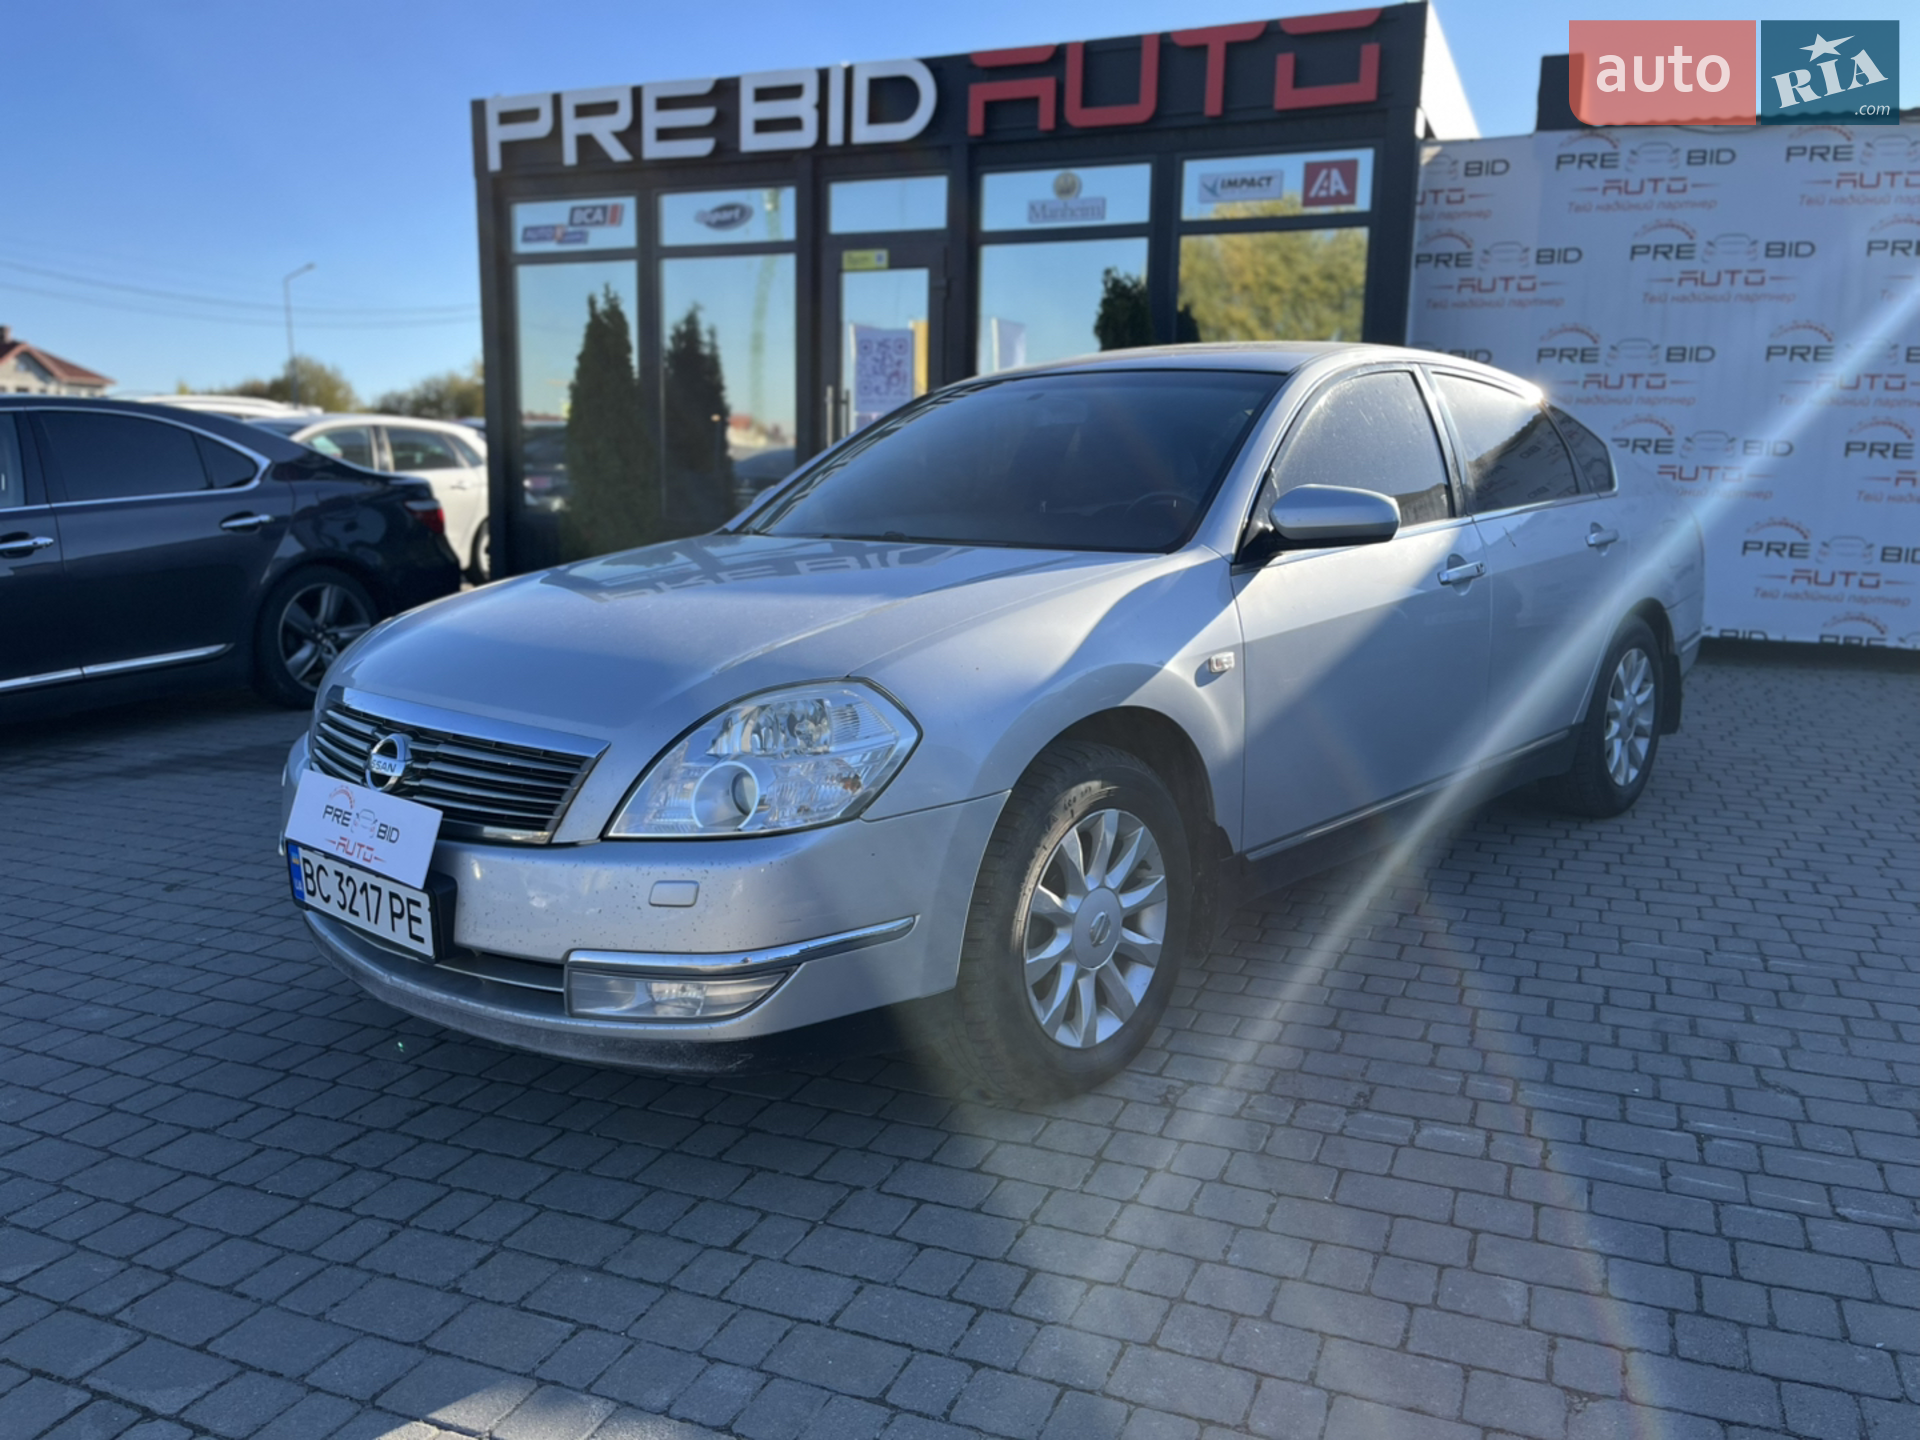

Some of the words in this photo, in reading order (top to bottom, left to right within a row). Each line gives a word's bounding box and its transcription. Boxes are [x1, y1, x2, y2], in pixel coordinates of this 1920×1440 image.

[486, 77, 717, 171] PRE
[740, 59, 937, 152] BID
[967, 7, 1383, 136] AUTO
[1556, 152, 1620, 171] PRE
[1686, 148, 1737, 166] BID
[1785, 145, 1854, 163] PRE
[1464, 159, 1510, 177] BID
[1220, 175, 1273, 190] IMPACT
[1602, 177, 1688, 196] AUTO
[1416, 188, 1465, 206] UTO
[1630, 243, 1696, 261] PRE
[1765, 241, 1816, 258] BID
[1867, 240, 1920, 257] PR
[1414, 252, 1474, 269] PRE
[1535, 247, 1583, 265] BID
[1457, 275, 1537, 293] AUTO
[1678, 269, 1766, 287] AUTO
[1537, 347, 1600, 363] PRE
[1666, 346, 1716, 363] BID
[1766, 345, 1834, 362] PRE
[1582, 373, 1667, 389] AUTO
[1844, 442, 1914, 459] PRE
[1742, 541, 1810, 559] PRE
[1791, 569, 1881, 589] AUTO
[322, 804, 352, 827] PRE
[376, 823, 400, 844] BID
[336, 836, 374, 863] AUTO
[302, 857, 331, 904] BC
[334, 869, 382, 925] 3217
[389, 890, 425, 944] PE
